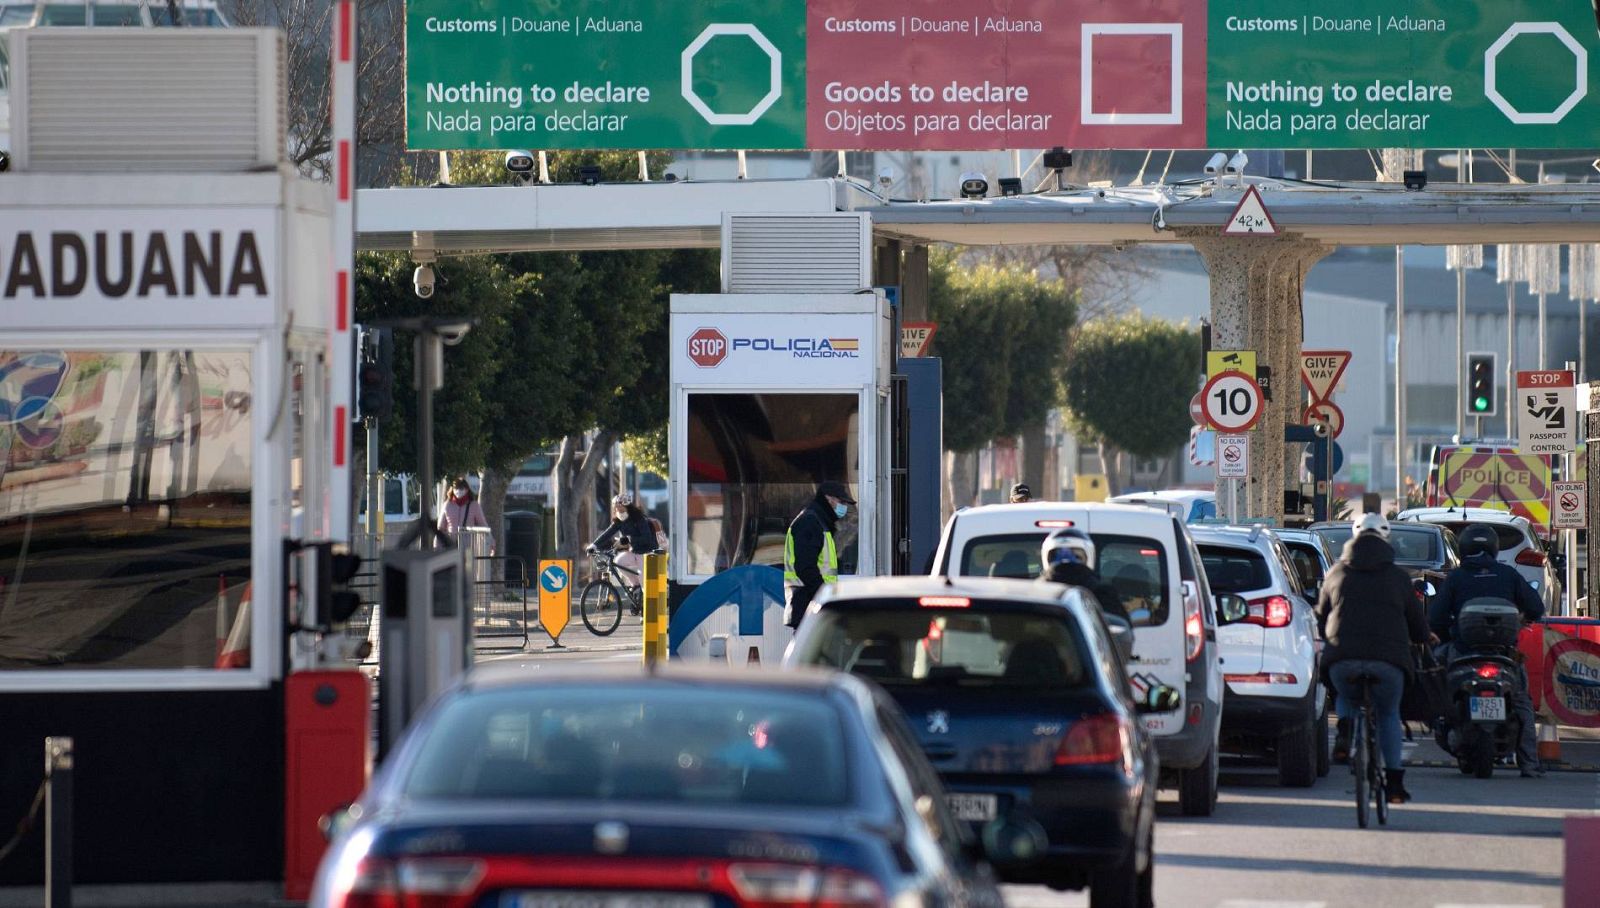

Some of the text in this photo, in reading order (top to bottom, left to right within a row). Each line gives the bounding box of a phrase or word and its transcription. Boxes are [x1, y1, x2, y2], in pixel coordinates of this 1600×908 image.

[425, 17, 643, 32] Customs Douane Aduana
[824, 17, 1042, 32] Customs Douane Aduana
[1225, 16, 1446, 32] Customs Douane Aduana
[426, 81, 650, 108] Nothing to declare
[824, 81, 1029, 103] Goods to declare
[1226, 80, 1453, 107] Nothing to declare
[426, 110, 628, 136] Nada para declarar
[824, 109, 1052, 136] Objetos para declarar
[1226, 109, 1430, 135] Nada para declarar
[691, 338, 724, 356] STOP
[1304, 358, 1337, 369] GIVE
[1310, 369, 1334, 379] WAY
[1530, 374, 1561, 384] STOP
[1213, 387, 1251, 416] 10
[1529, 432, 1568, 440] PASSPORT
[1530, 444, 1567, 452] CONTROL
[1462, 470, 1529, 484] POLICE
[1571, 660, 1599, 680] ALTO
